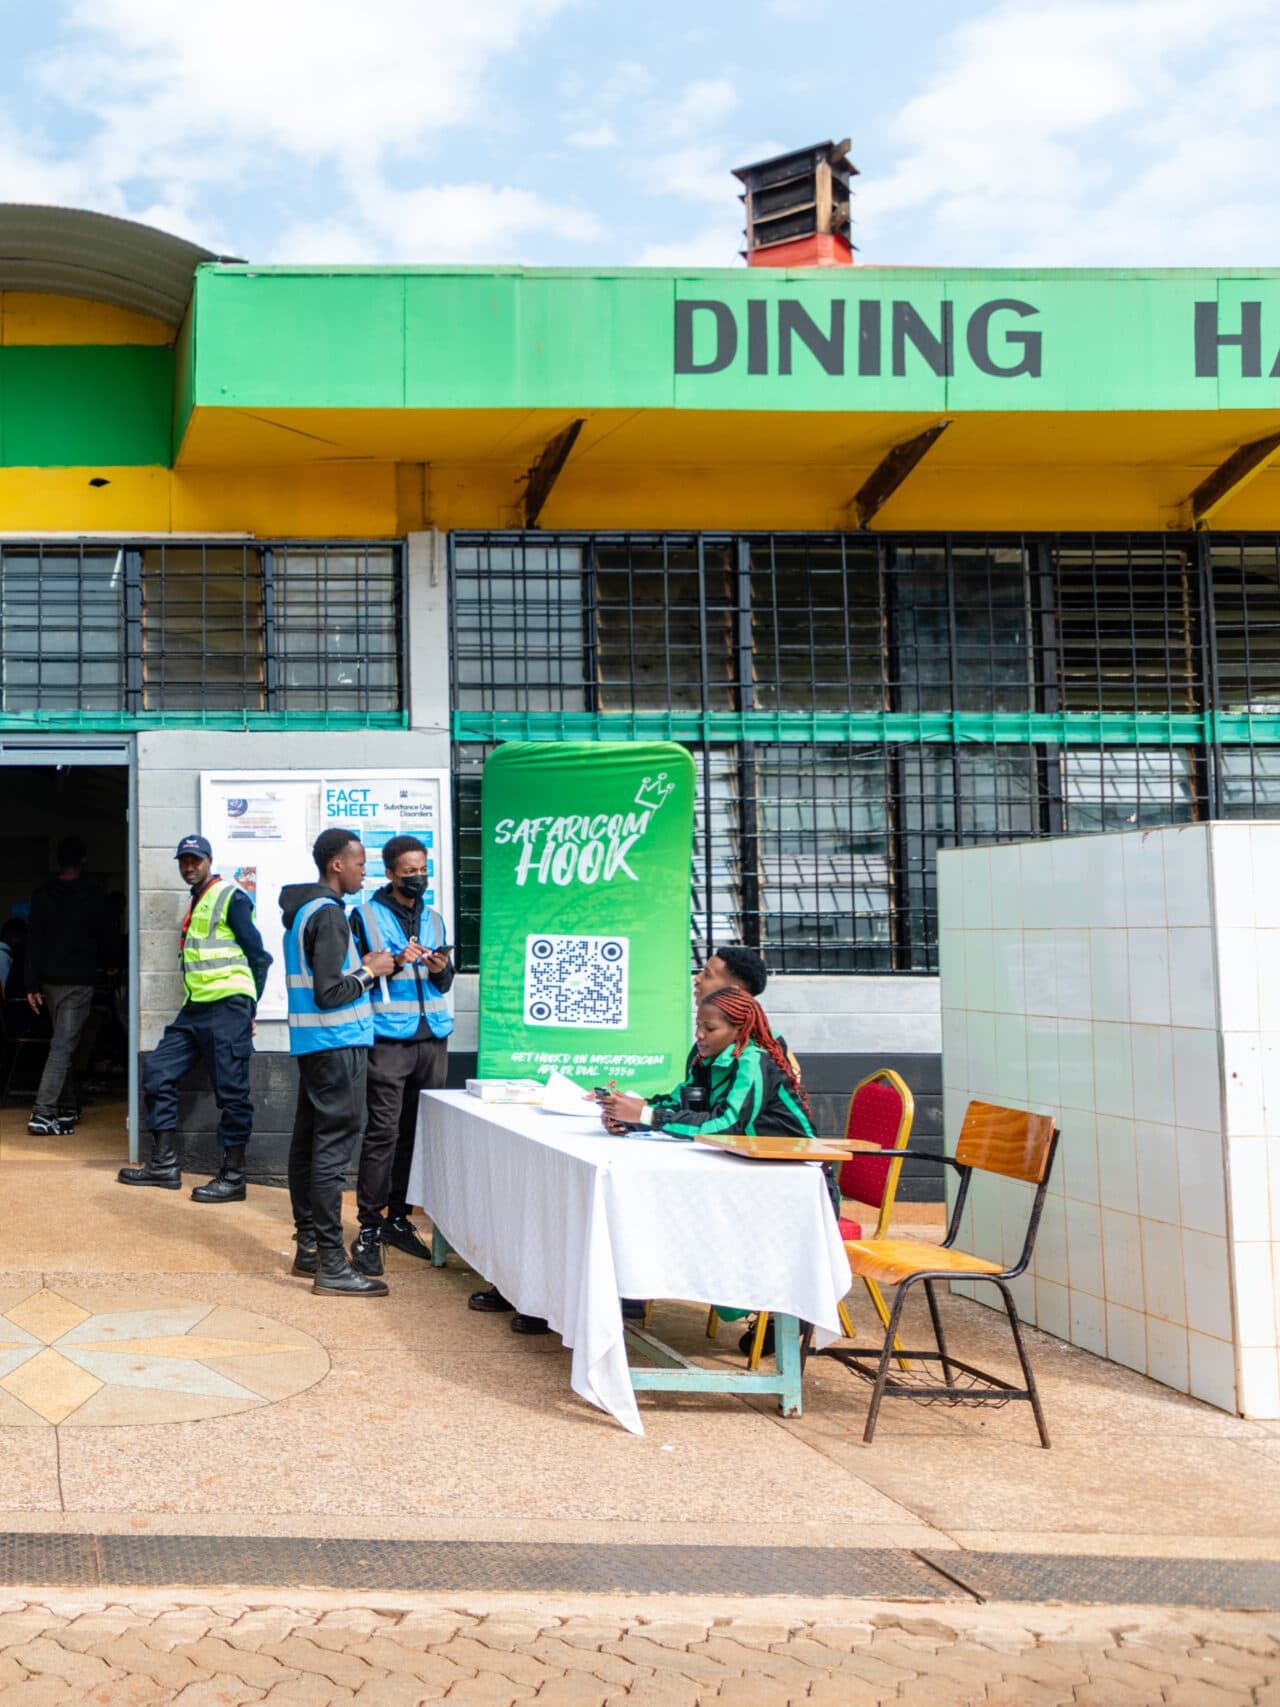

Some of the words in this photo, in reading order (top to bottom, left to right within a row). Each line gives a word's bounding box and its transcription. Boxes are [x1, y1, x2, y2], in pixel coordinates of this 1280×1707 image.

[674, 298, 1043, 378] DINING
[1194, 301, 1280, 378] H
[326, 789, 371, 802] FACT
[326, 803, 380, 817] SHEET
[383, 803, 419, 811] Substance
[494, 811, 651, 846] SAFARICOM
[514, 833, 641, 886] HOOK
[511, 1052, 533, 1063] GET
